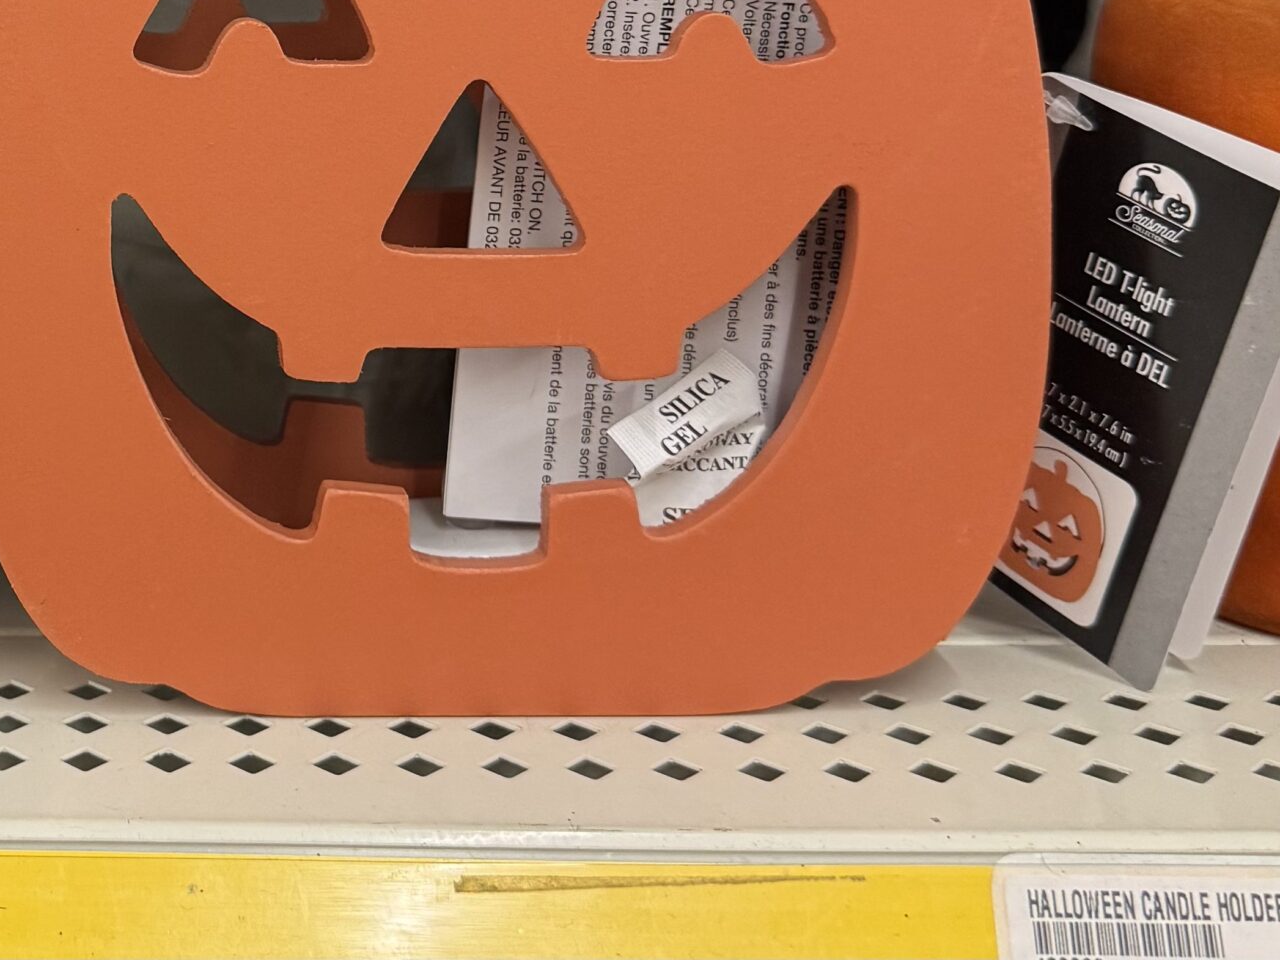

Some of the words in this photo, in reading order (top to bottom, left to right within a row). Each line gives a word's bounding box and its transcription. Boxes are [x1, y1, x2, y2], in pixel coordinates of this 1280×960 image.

[619, 11, 638, 57] Insére
[490, 146, 507, 197] AVANT
[517, 149, 530, 161] la
[511, 166, 529, 223] batterie:
[531, 161, 546, 204] ITCH
[487, 201, 502, 222] DE
[527, 208, 542, 235] ON.
[1115, 205, 1186, 244] Seasonal
[816, 217, 829, 247] une
[809, 251, 827, 312] batterie
[1083, 251, 1117, 286] LED
[1120, 269, 1175, 318] T-light
[763, 293, 778, 321] des
[1086, 285, 1152, 339] Lantern
[761, 323, 777, 354] fins
[1050, 301, 1119, 359] Lanterne
[1120, 344, 1133, 367] à
[1135, 351, 1171, 389] DEL
[548, 379, 563, 398] de
[602, 382, 616, 402] vis
[658, 371, 732, 424] SILICA
[546, 401, 561, 414] la
[580, 383, 599, 445] batteries
[600, 405, 615, 424] du
[1058, 392, 1067, 405] x
[1068, 395, 1088, 416] 2.1
[1088, 410, 1097, 423] x
[1098, 413, 1121, 435] 7.6
[1119, 426, 1134, 444] in
[542, 417, 560, 471] batterie
[660, 420, 709, 457] GEL
[1074, 428, 1084, 441] x
[1083, 429, 1107, 454] 19.4
[578, 447, 590, 479] sont
[1026, 888, 1137, 920] HALLOWEEN
[1141, 890, 1211, 921] CANDLE
